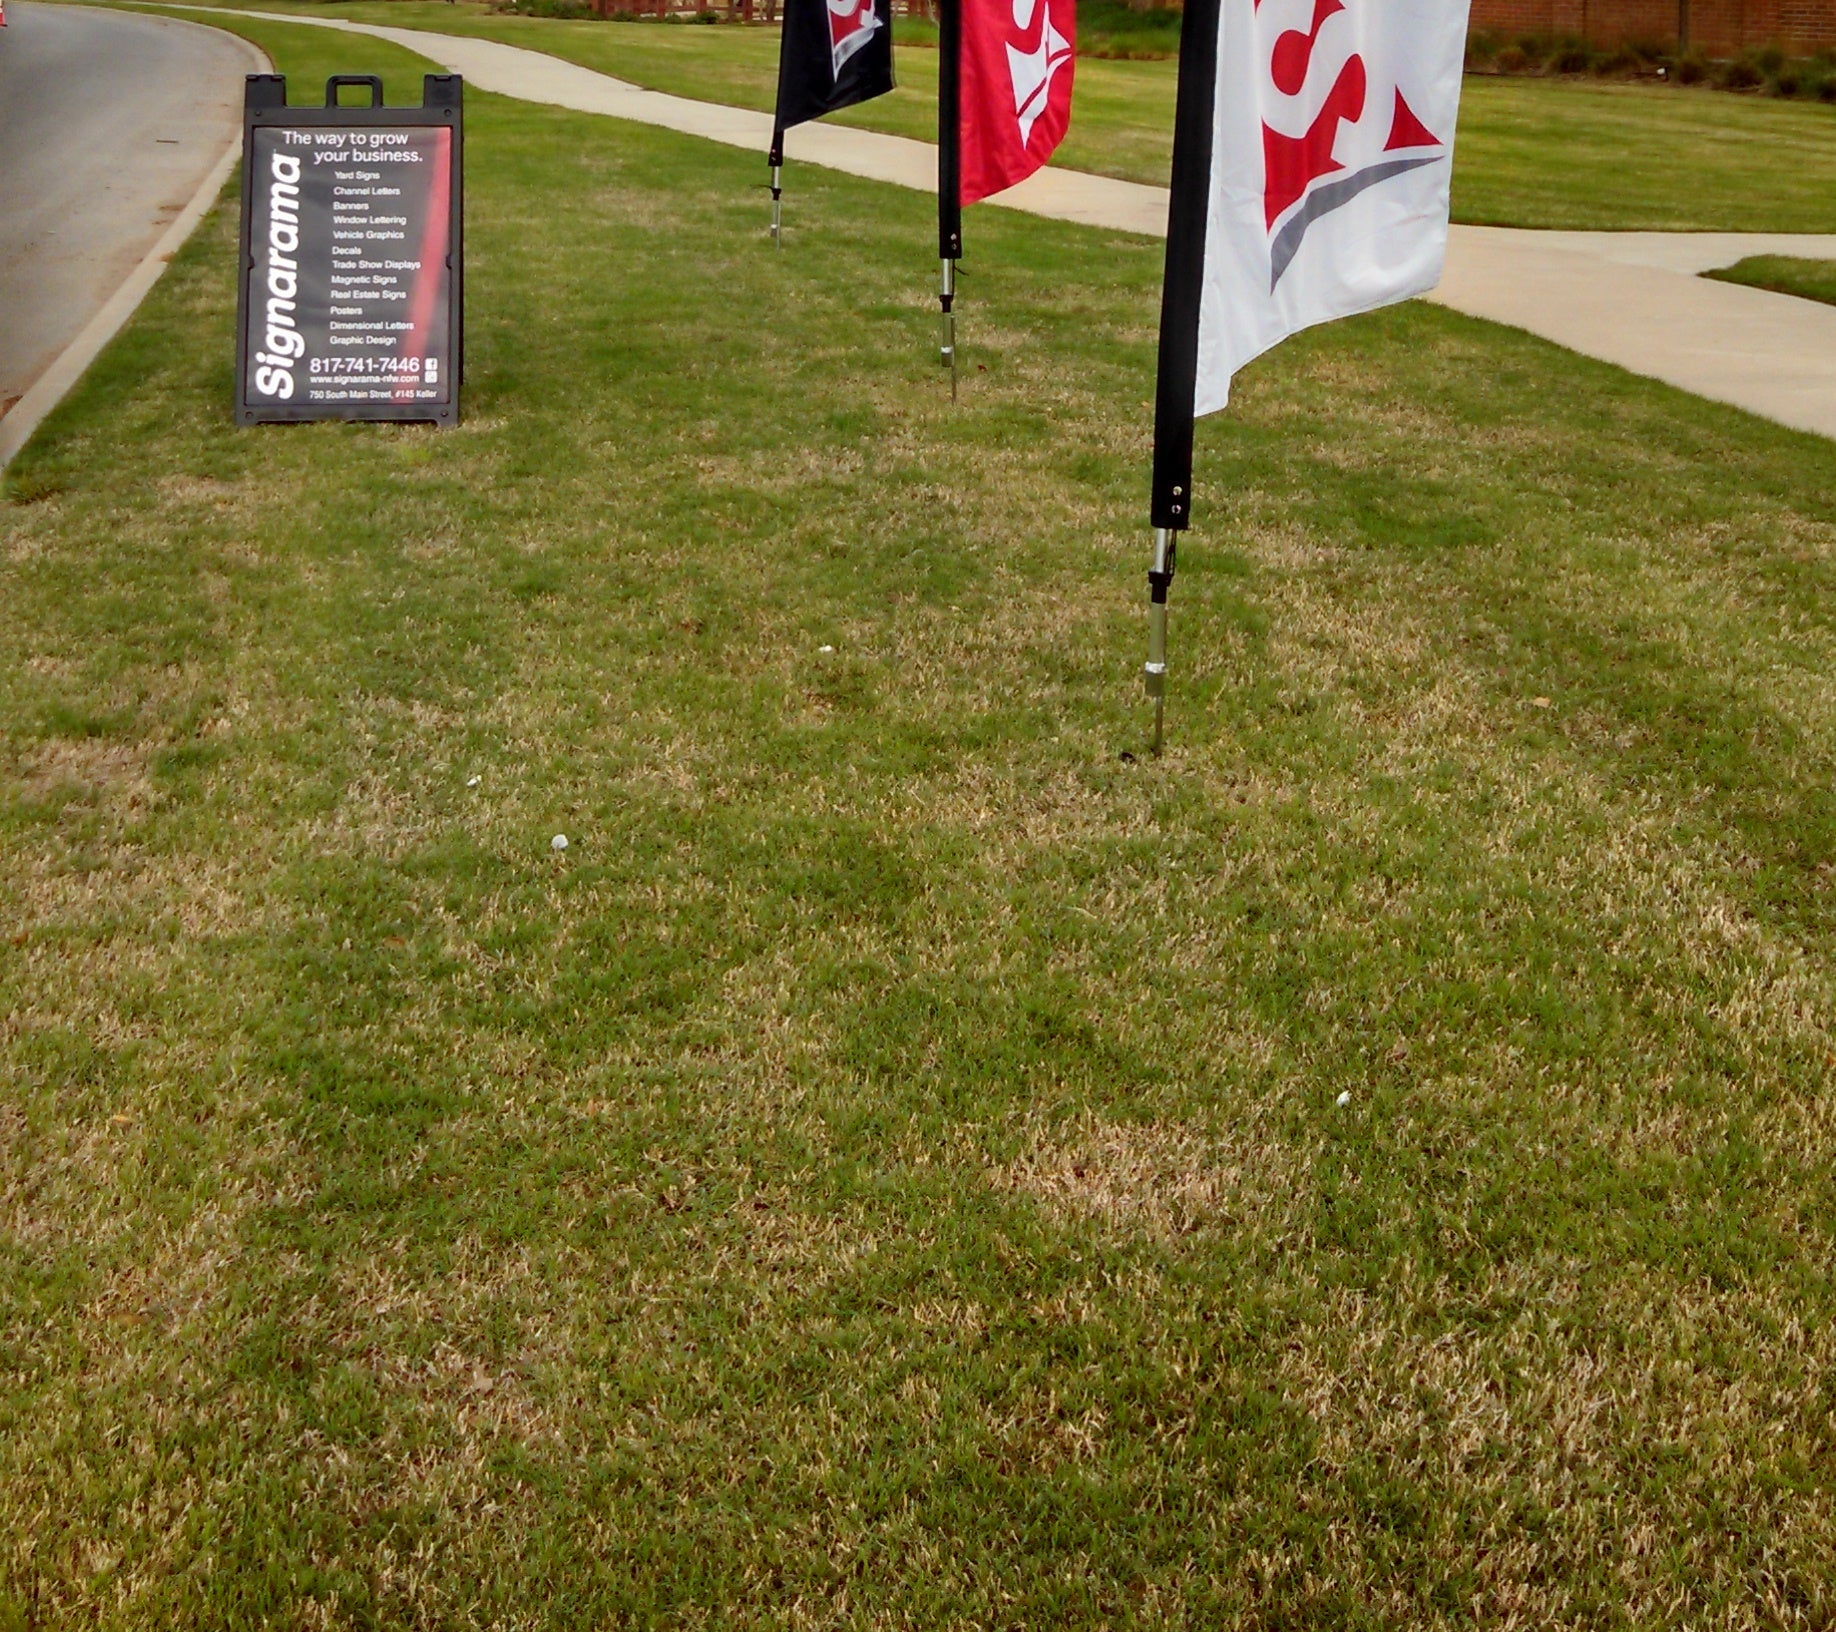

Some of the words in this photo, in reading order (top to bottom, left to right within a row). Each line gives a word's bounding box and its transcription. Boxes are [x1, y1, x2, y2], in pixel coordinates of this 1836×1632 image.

[282, 131, 312, 145] The
[315, 133, 346, 147] way
[349, 132, 367, 145] to
[369, 134, 409, 148] grow
[313, 151, 350, 165] your
[352, 148, 423, 162] business.
[334, 171, 354, 179] Yard
[356, 171, 380, 181] Signs
[333, 187, 370, 195] Channel
[372, 187, 401, 196] Letters
[333, 201, 369, 210] Banners
[333, 216, 367, 224] Window
[369, 216, 407, 226] Lettering
[332, 230, 364, 239] Vehicle
[366, 230, 405, 240] Graphics
[332, 246, 362, 255] Decals
[332, 260, 357, 269] Trade
[359, 260, 383, 269] Show
[385, 260, 421, 270] Displays
[255, 153, 306, 400] Signarama
[331, 275, 371, 285] Magnetic
[372, 275, 397, 285] Signs
[330, 290, 351, 299] Real
[353, 290, 380, 299] Estate
[382, 290, 407, 300] Signs
[330, 306, 363, 315] Posters
[330, 321, 384, 330] Dimensional
[385, 321, 415, 330] Letters
[330, 336, 364, 345] Graphic
[366, 336, 397, 346] Design
[309, 357, 420, 373] 817-741-7446
[309, 390, 324, 399] 750
[325, 390, 348, 399] South
[349, 390, 368, 399] Main
[395, 390, 415, 399] #145
[416, 389, 438, 399] Keller
